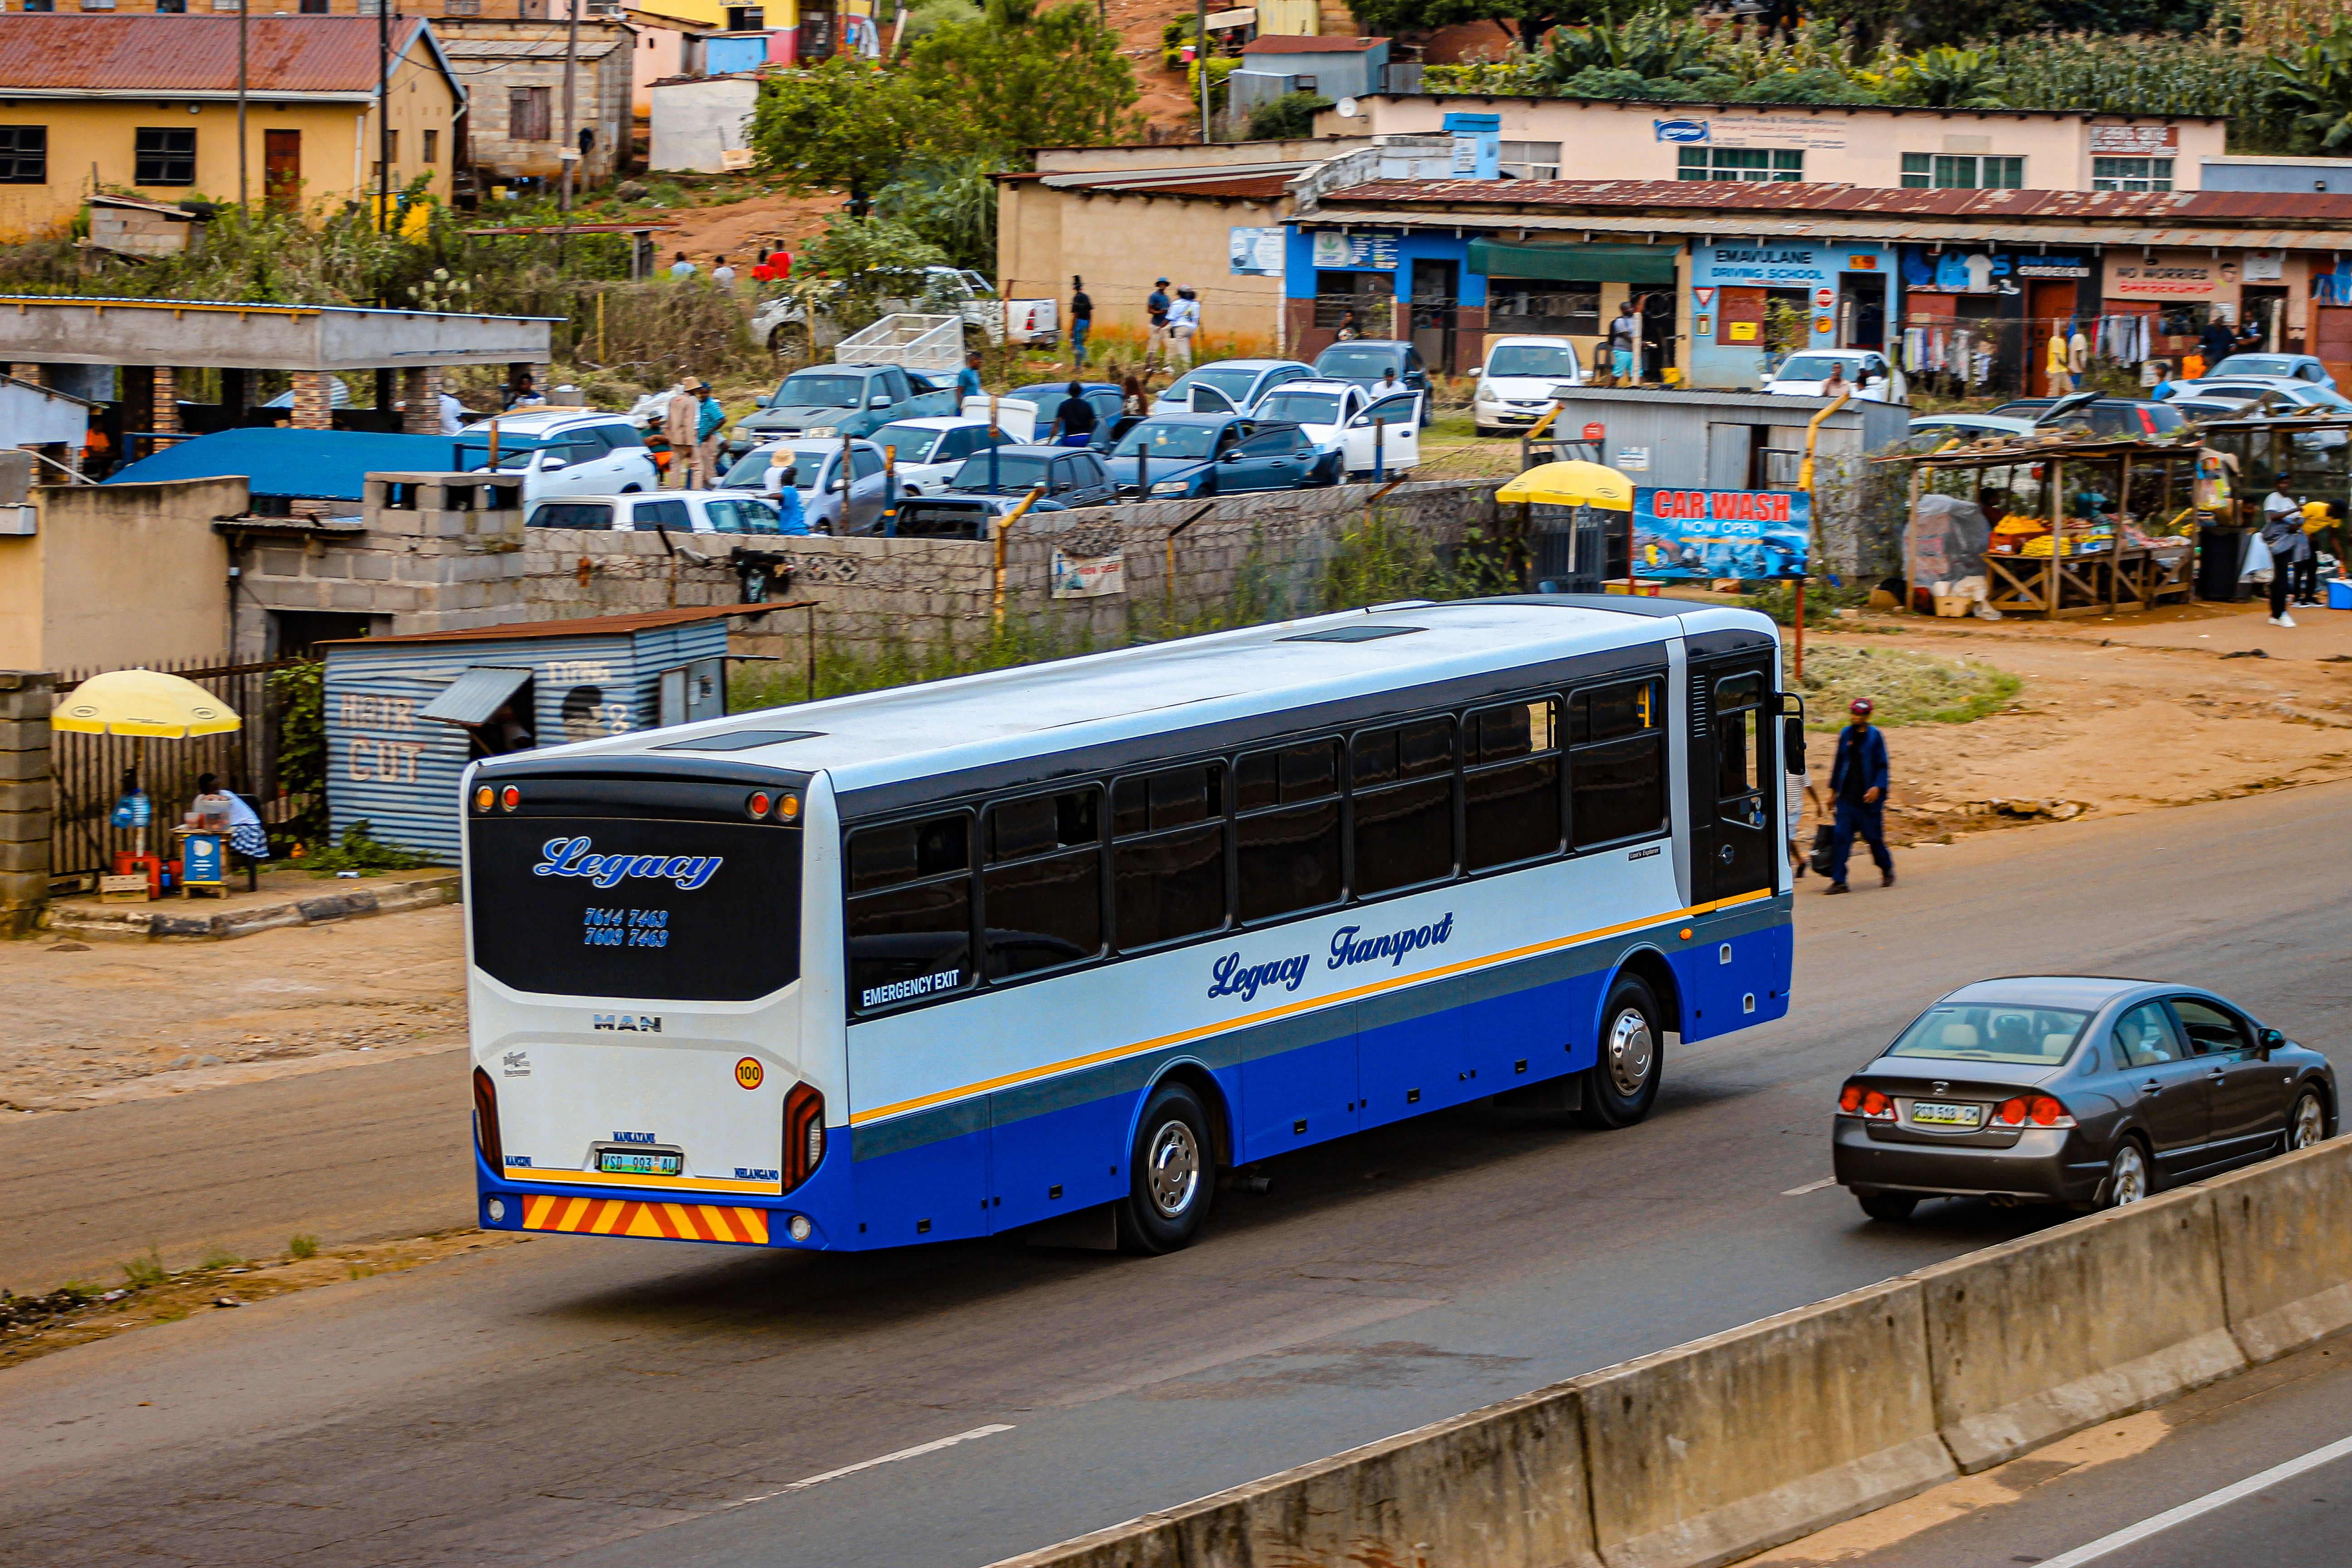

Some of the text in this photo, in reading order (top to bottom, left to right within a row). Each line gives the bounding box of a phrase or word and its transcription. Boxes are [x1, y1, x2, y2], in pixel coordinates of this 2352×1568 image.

[1715, 250, 1813, 264] EMAVULANE
[1711, 267, 1825, 279] DRIVING SCHOOL
[1652, 490, 1792, 522] CAR WASH
[1681, 521, 1760, 534] NOW OPEN
[341, 691, 415, 731] HAIR
[348, 734, 426, 783] CUT
[1642, 848, 1659, 856] Explorer
[533, 836, 724, 890] Legacy
[584, 908, 669, 928] 7614 7463
[584, 928, 669, 947] 7603 7463
[1207, 911, 1454, 1003] Legacy Transport
[862, 969, 959, 1007] EMERGENCY EXIT
[593, 1013, 662, 1033] MAN
[739, 1065, 759, 1081] 100
[603, 1155, 674, 1172] YSD 993 AL
